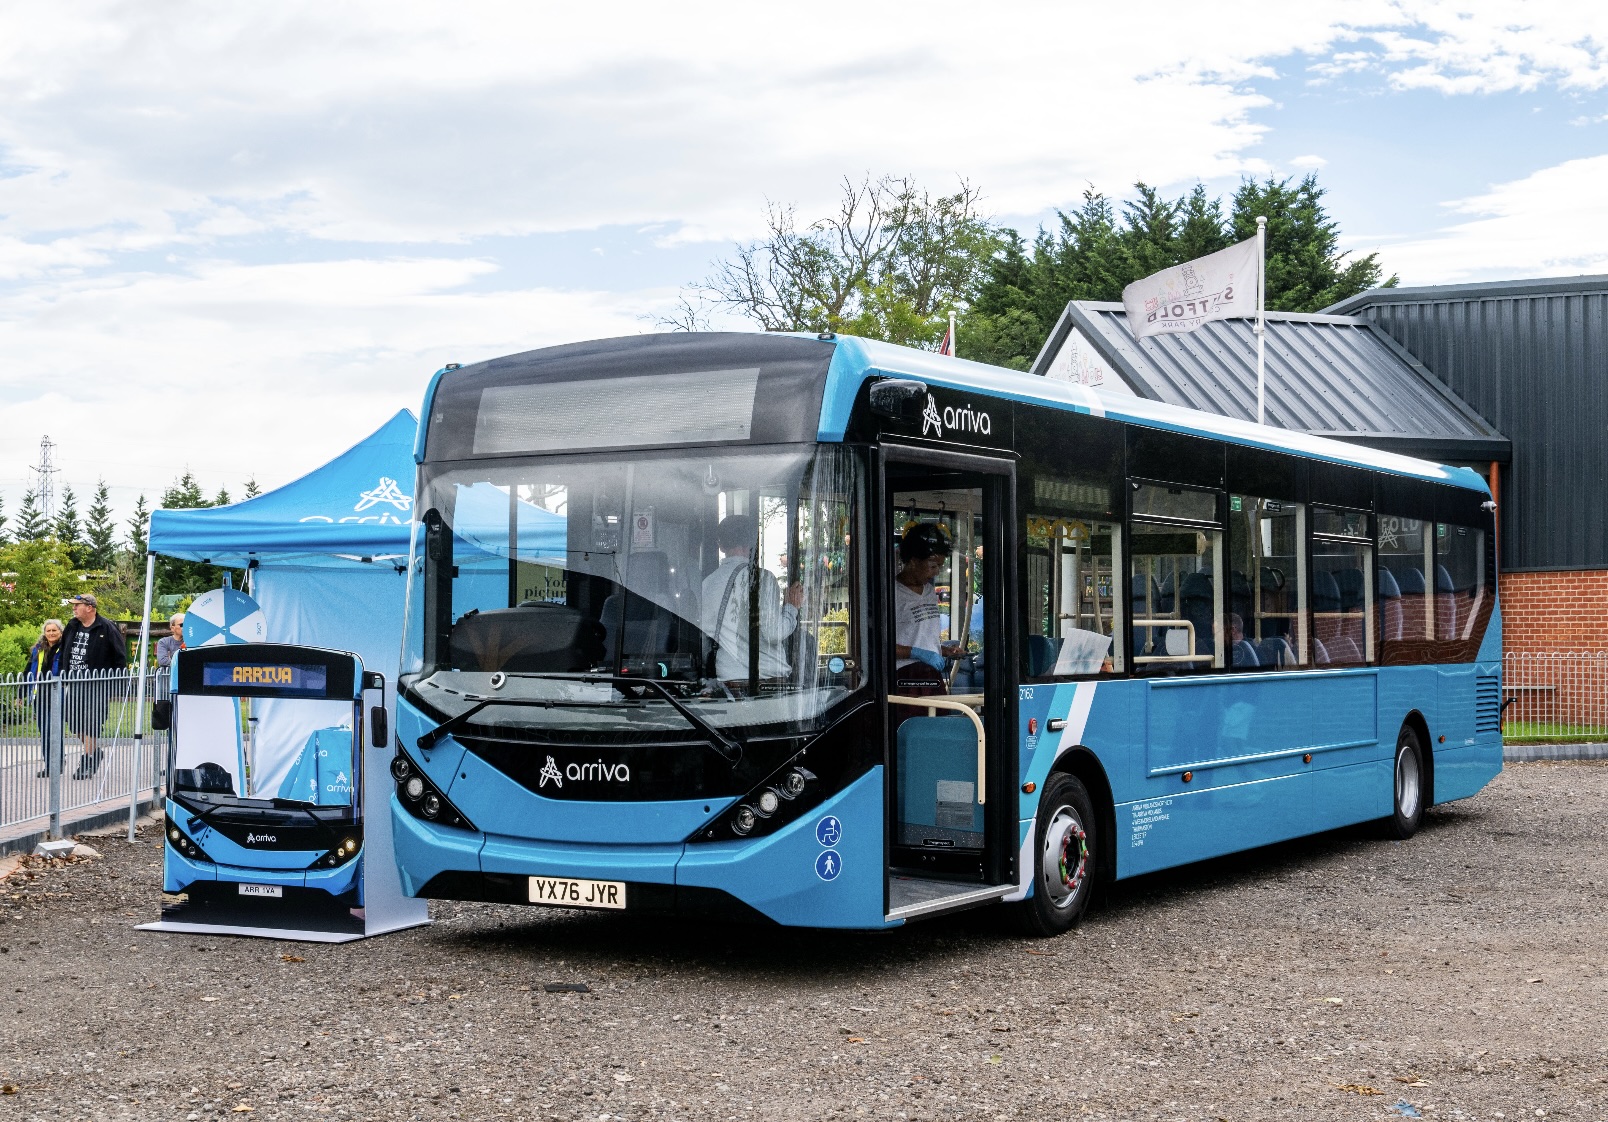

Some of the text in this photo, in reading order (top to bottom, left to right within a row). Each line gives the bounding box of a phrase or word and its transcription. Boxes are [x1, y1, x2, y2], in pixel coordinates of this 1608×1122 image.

[943, 403, 991, 436] arriva
[1378, 517, 1419, 533] FOLD
[524, 586, 567, 600] pictur
[232, 666, 292, 684] ARRIVA
[1019, 687, 1034, 700] 2162
[566, 758, 630, 782] arriva
[255, 833, 277, 843] arriva
[536, 879, 618, 905] YX76 JYR
